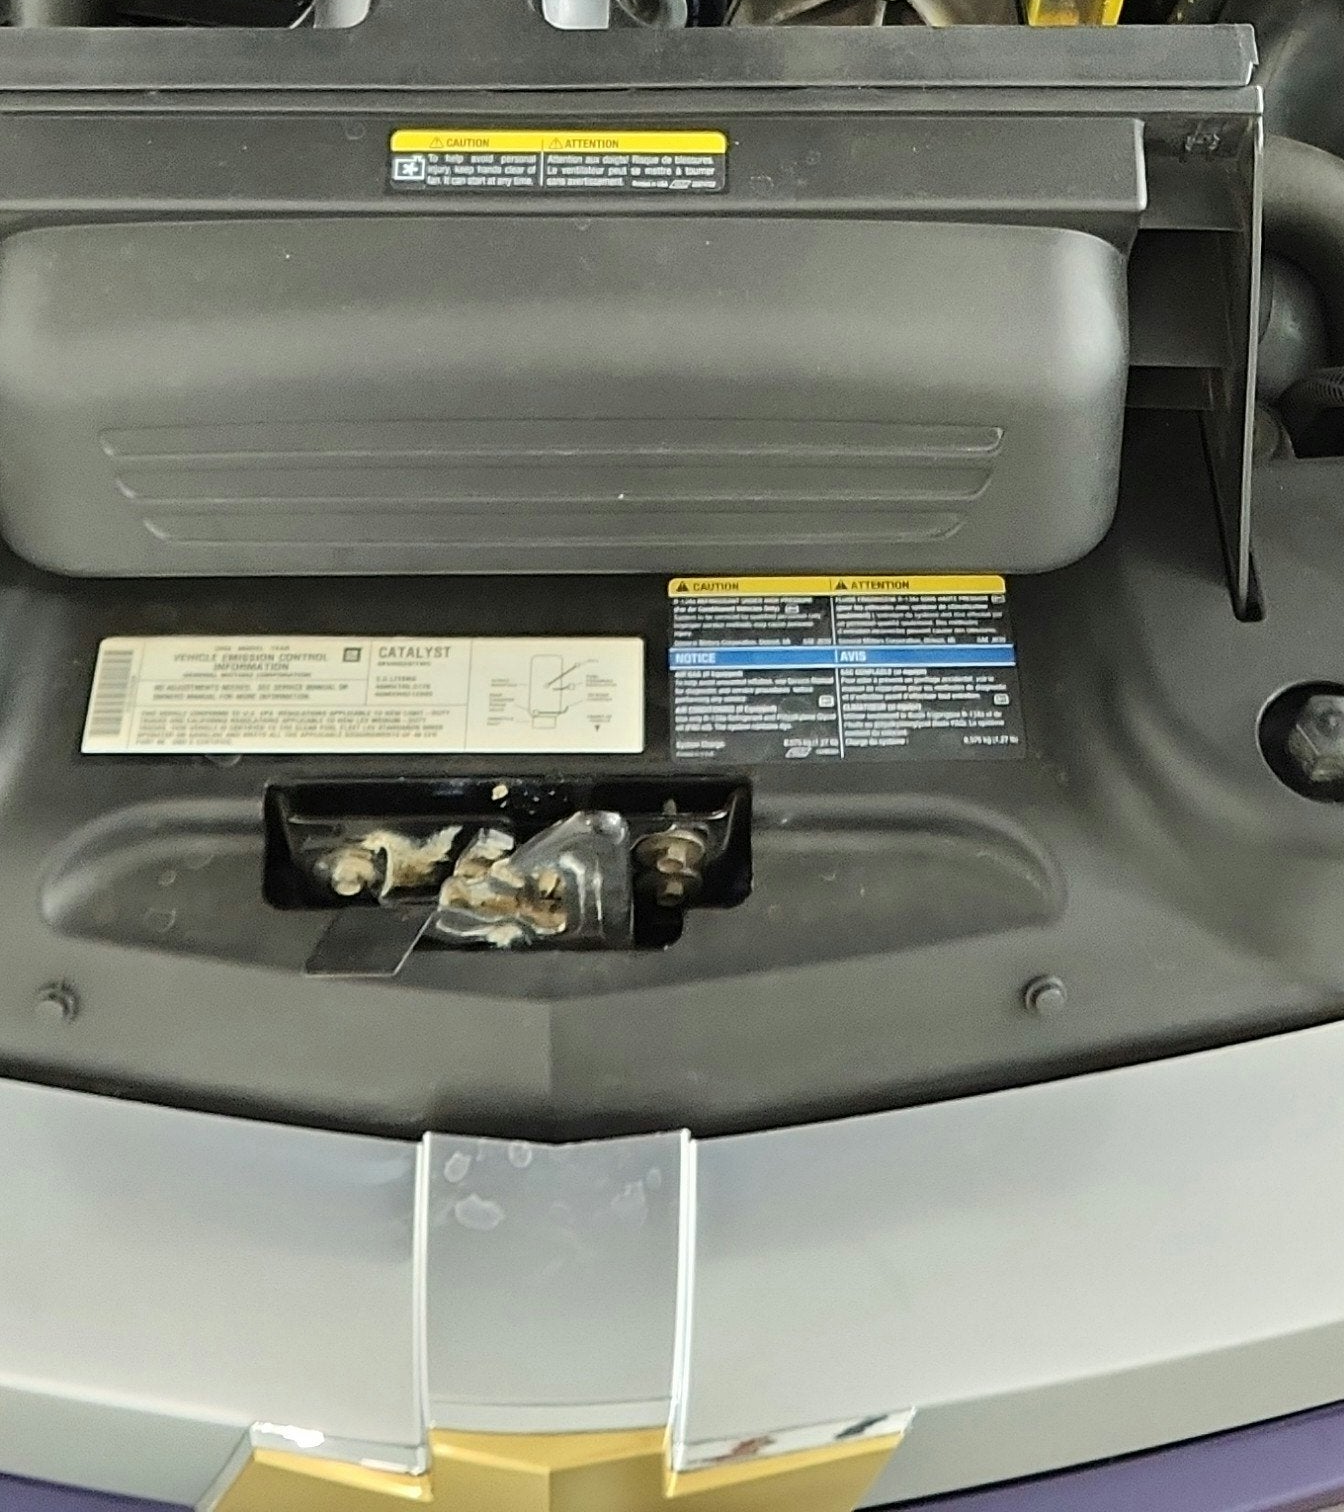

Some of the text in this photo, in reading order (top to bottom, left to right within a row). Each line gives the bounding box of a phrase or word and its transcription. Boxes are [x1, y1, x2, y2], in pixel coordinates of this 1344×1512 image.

[446, 138, 490, 148] CAUTION
[565, 139, 619, 149] ATTENTION
[693, 582, 739, 591] CAUTION
[851, 580, 910, 590] ATTENTION
[378, 646, 451, 658] CATALYST
[840, 651, 866, 662] AVIS
[174, 653, 329, 662] VEHICLE EMISSION CONTROL
[675, 653, 716, 663] NOTICE
